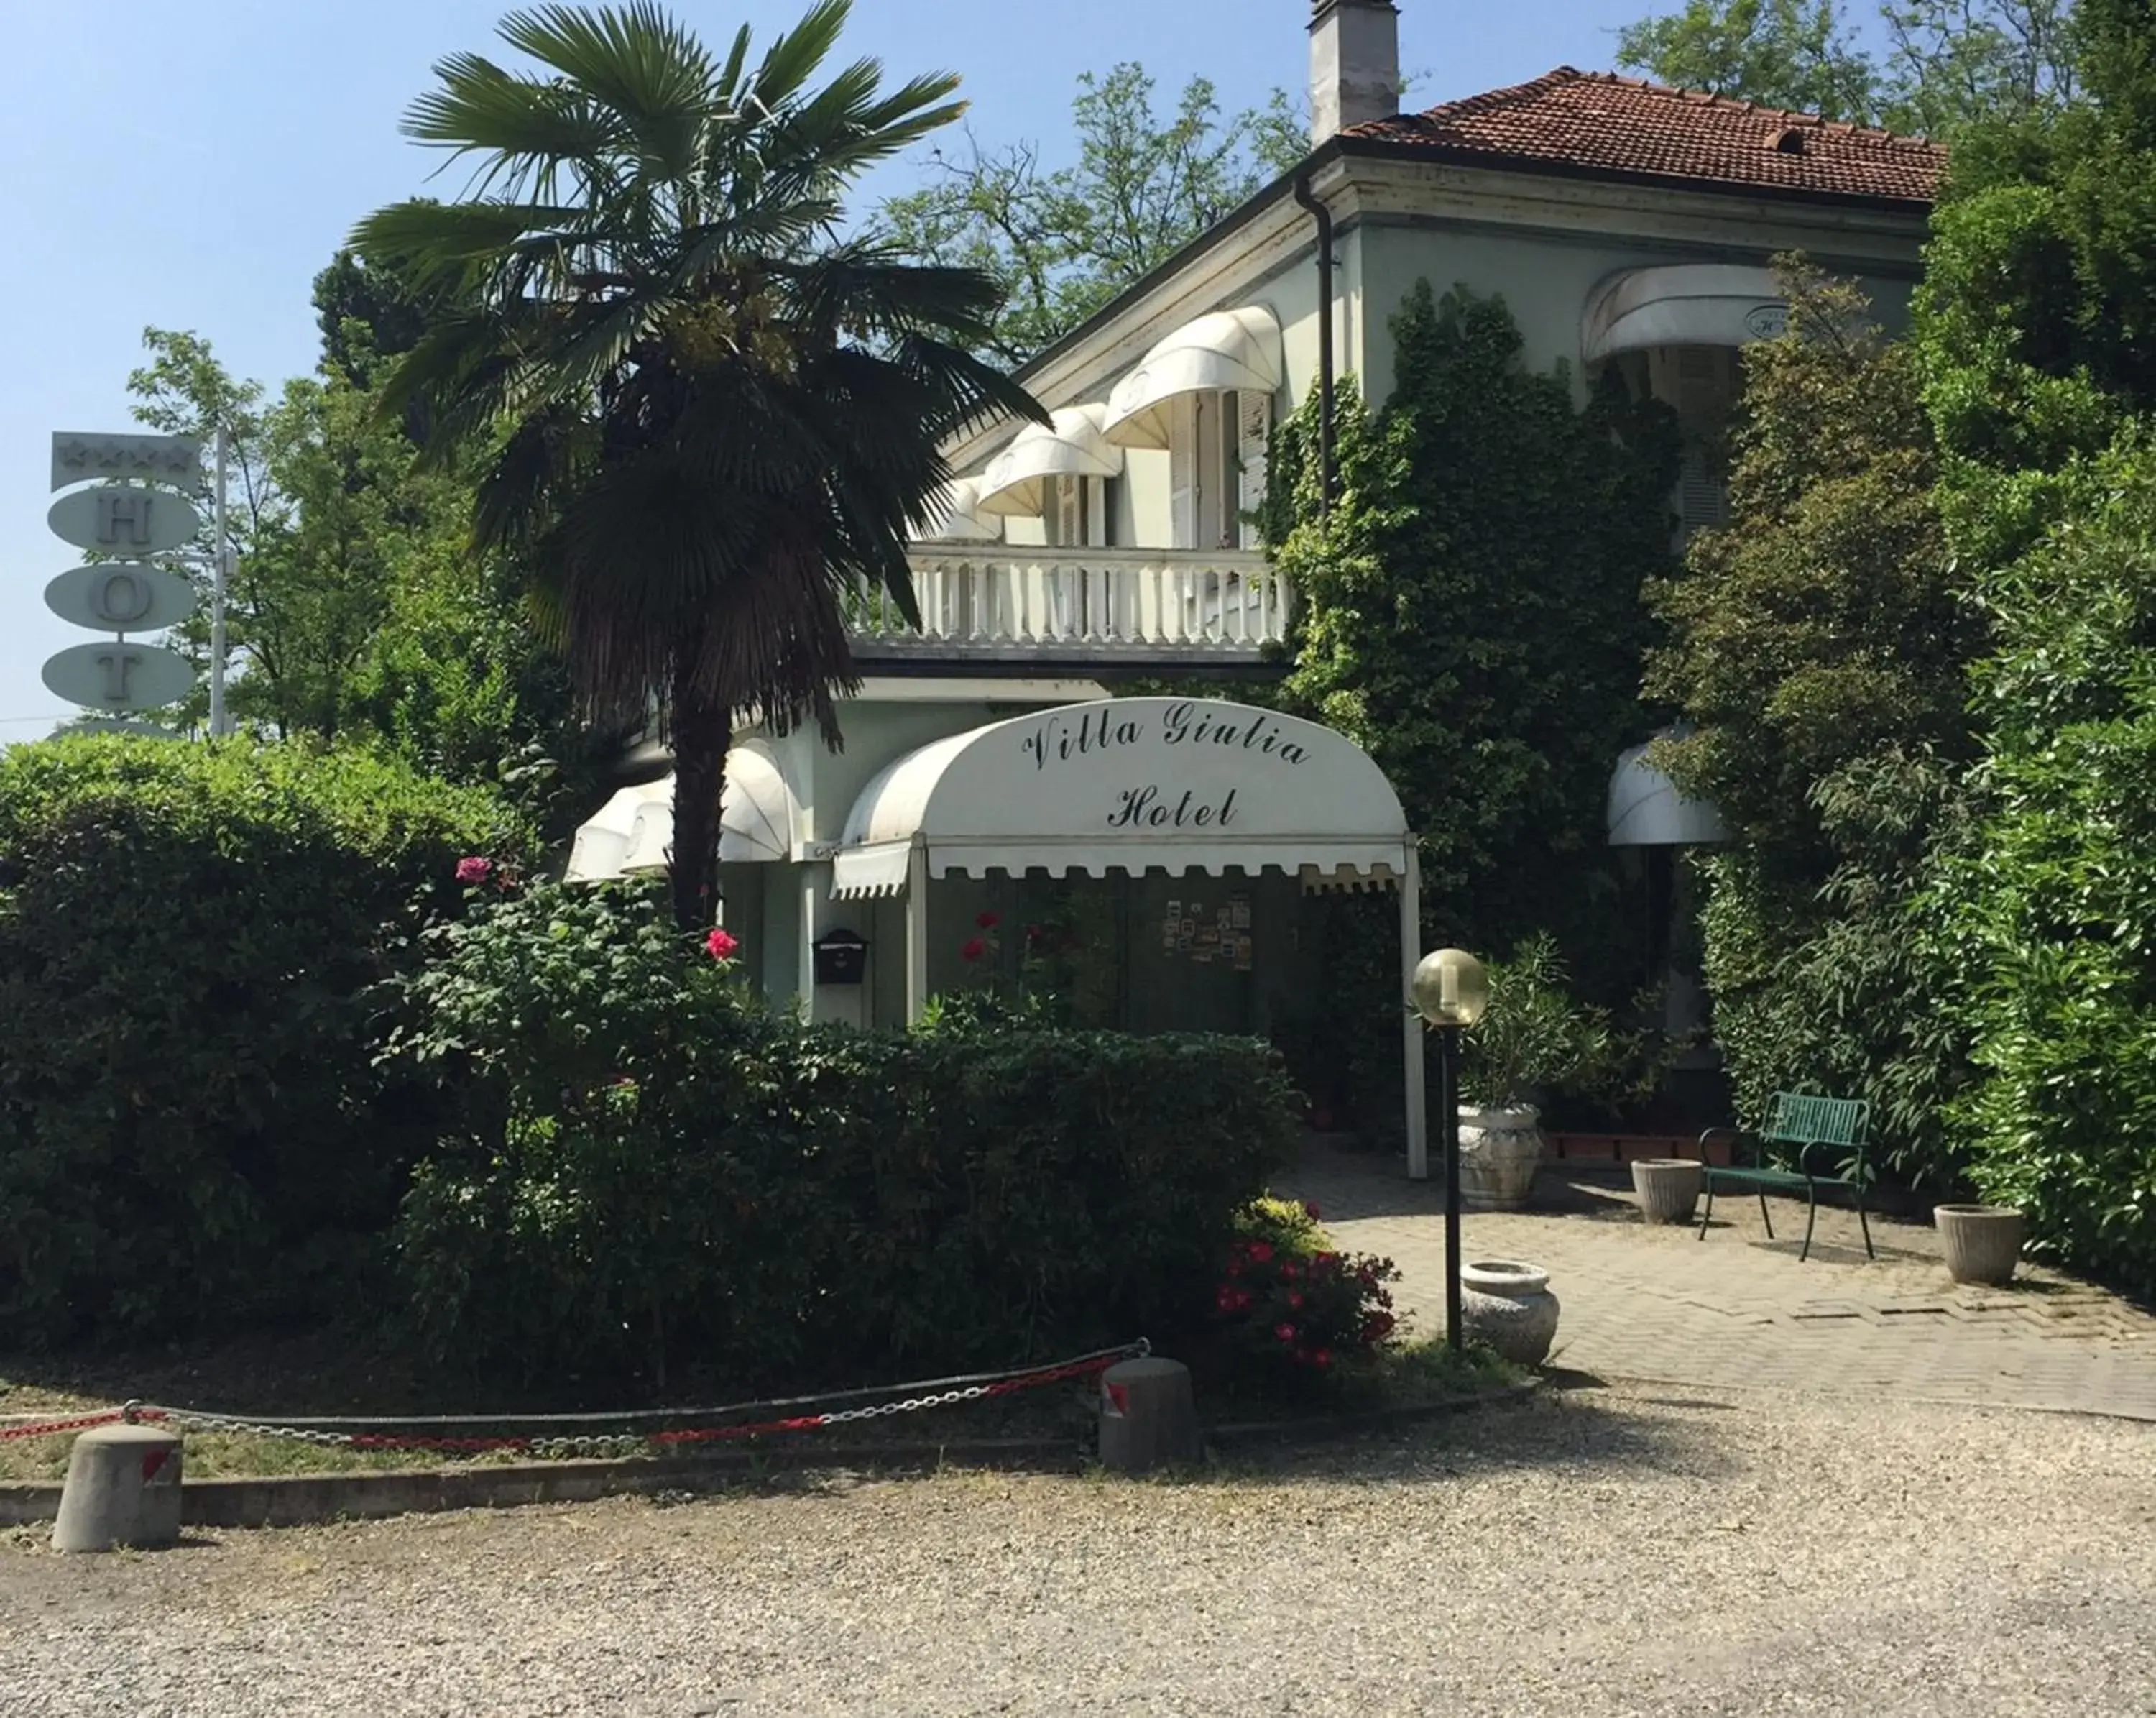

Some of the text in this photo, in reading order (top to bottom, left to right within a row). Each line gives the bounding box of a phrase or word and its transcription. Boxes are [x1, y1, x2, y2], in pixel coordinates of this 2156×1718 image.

[1022, 702, 1311, 770] Villa Giulia
[1106, 784, 1238, 828] Hotel
